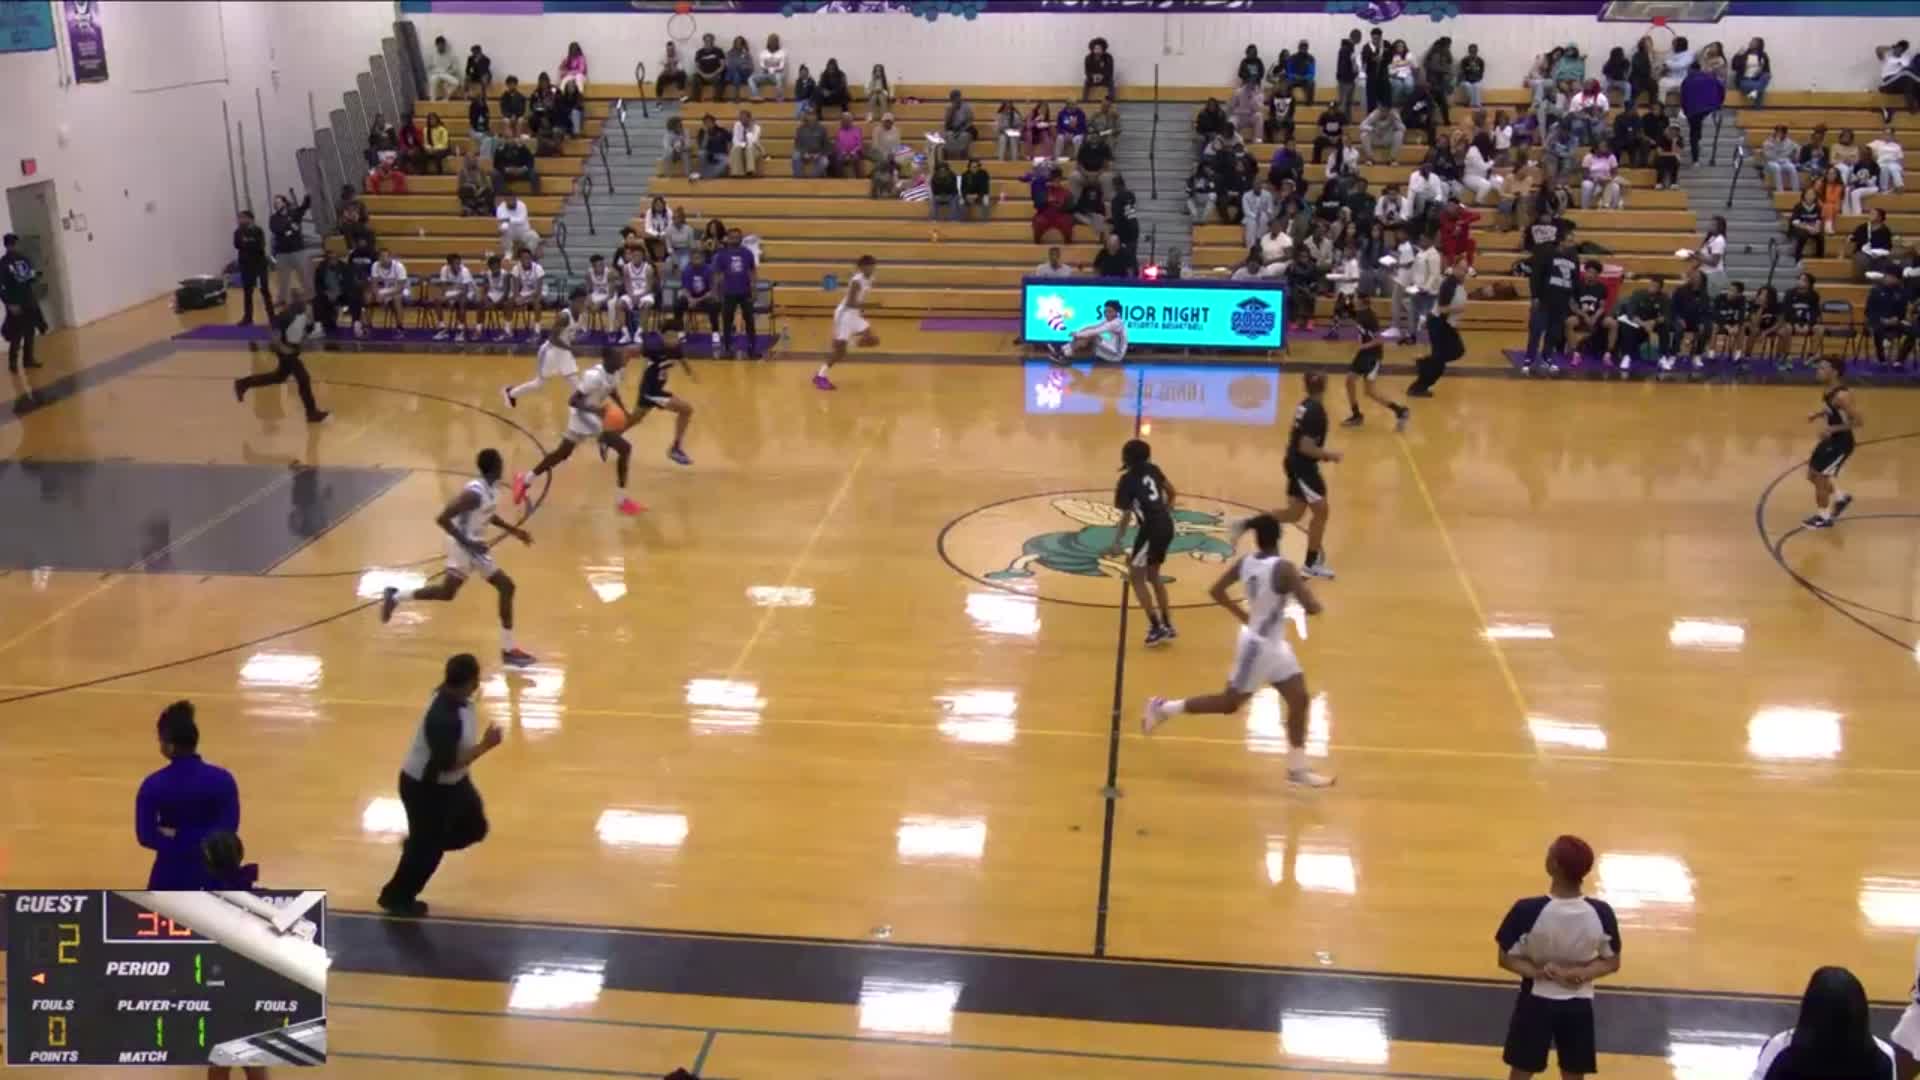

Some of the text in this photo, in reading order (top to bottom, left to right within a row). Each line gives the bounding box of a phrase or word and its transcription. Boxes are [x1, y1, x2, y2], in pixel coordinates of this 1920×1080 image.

[1096, 305, 1209, 323] SIOR NIGHT
[1143, 475, 1159, 501] 3
